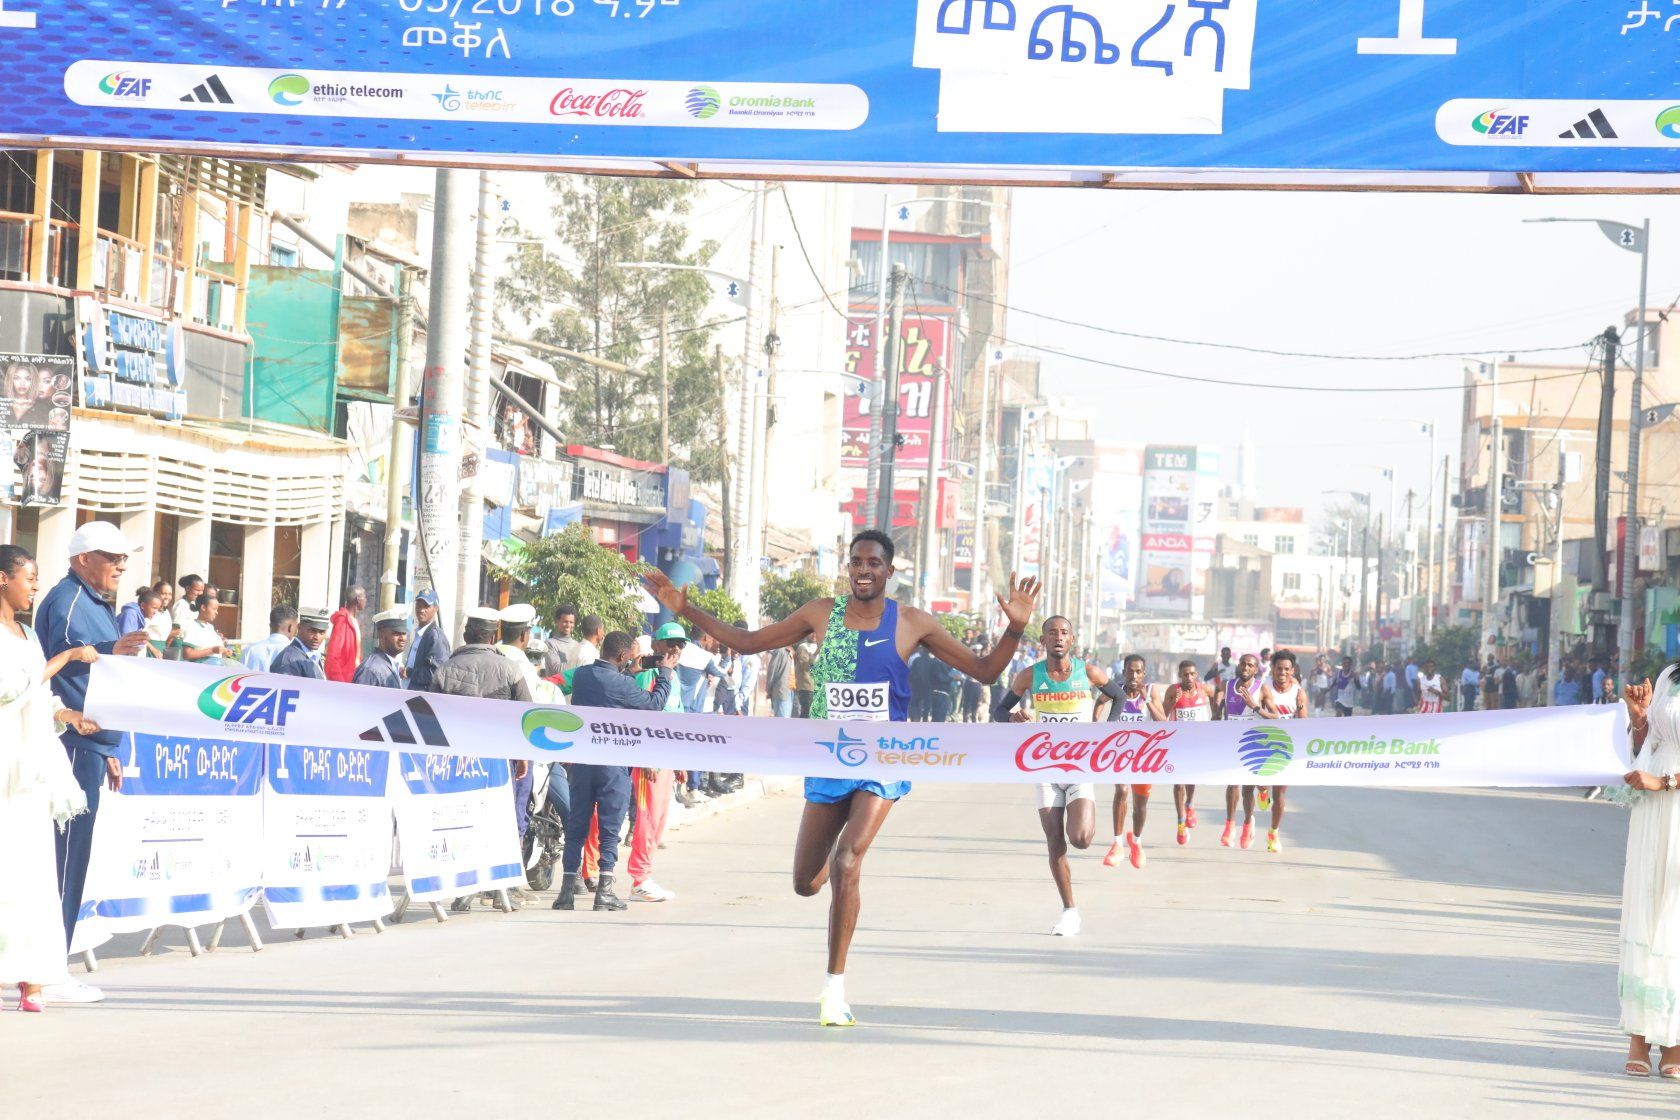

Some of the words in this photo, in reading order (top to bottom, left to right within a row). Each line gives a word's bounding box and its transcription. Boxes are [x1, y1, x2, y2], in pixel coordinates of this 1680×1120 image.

[402, 20, 511, 59] መቐለ
[114, 77, 152, 97] EAF
[313, 83, 347, 97] ethio
[350, 85, 403, 99] telecom
[464, 100, 517, 112] telebirr
[550, 87, 648, 118] Coca-Cola
[728, 94, 782, 107] Oromia
[782, 97, 816, 108] Bank
[1487, 115, 1530, 135] EAF
[1154, 453, 1188, 468] TEM
[829, 687, 884, 708] 3965
[1035, 690, 1087, 702] ETHIOPIA
[224, 687, 300, 726] EAF
[590, 720, 642, 737] ethio
[646, 726, 727, 745] telecom
[1015, 729, 1178, 774] Coca-Cola
[1305, 734, 1387, 756] Oromia
[1389, 738, 1440, 755] Bank
[875, 750, 968, 766] telebirr
[1306, 759, 1343, 769] Baankii
[1344, 760, 1390, 771] Oromiyaa
